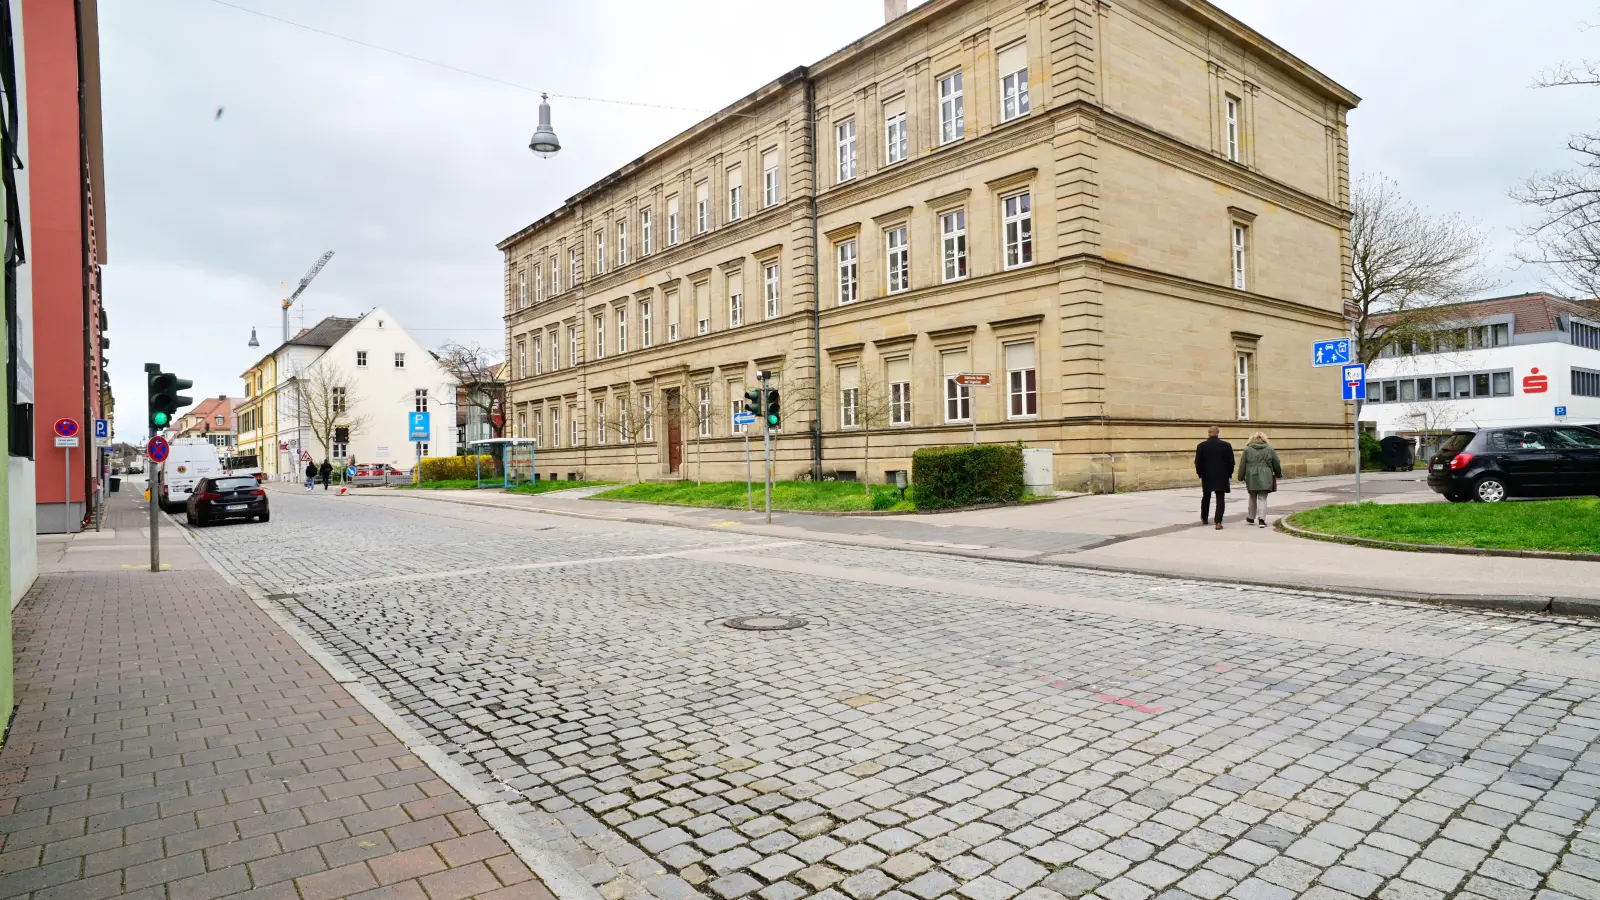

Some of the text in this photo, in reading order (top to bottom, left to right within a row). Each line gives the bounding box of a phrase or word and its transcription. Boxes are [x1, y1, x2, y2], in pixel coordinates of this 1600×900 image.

[1556, 407, 1564, 415] P
[415, 414, 424, 425] P
[96, 421, 104, 436] P
